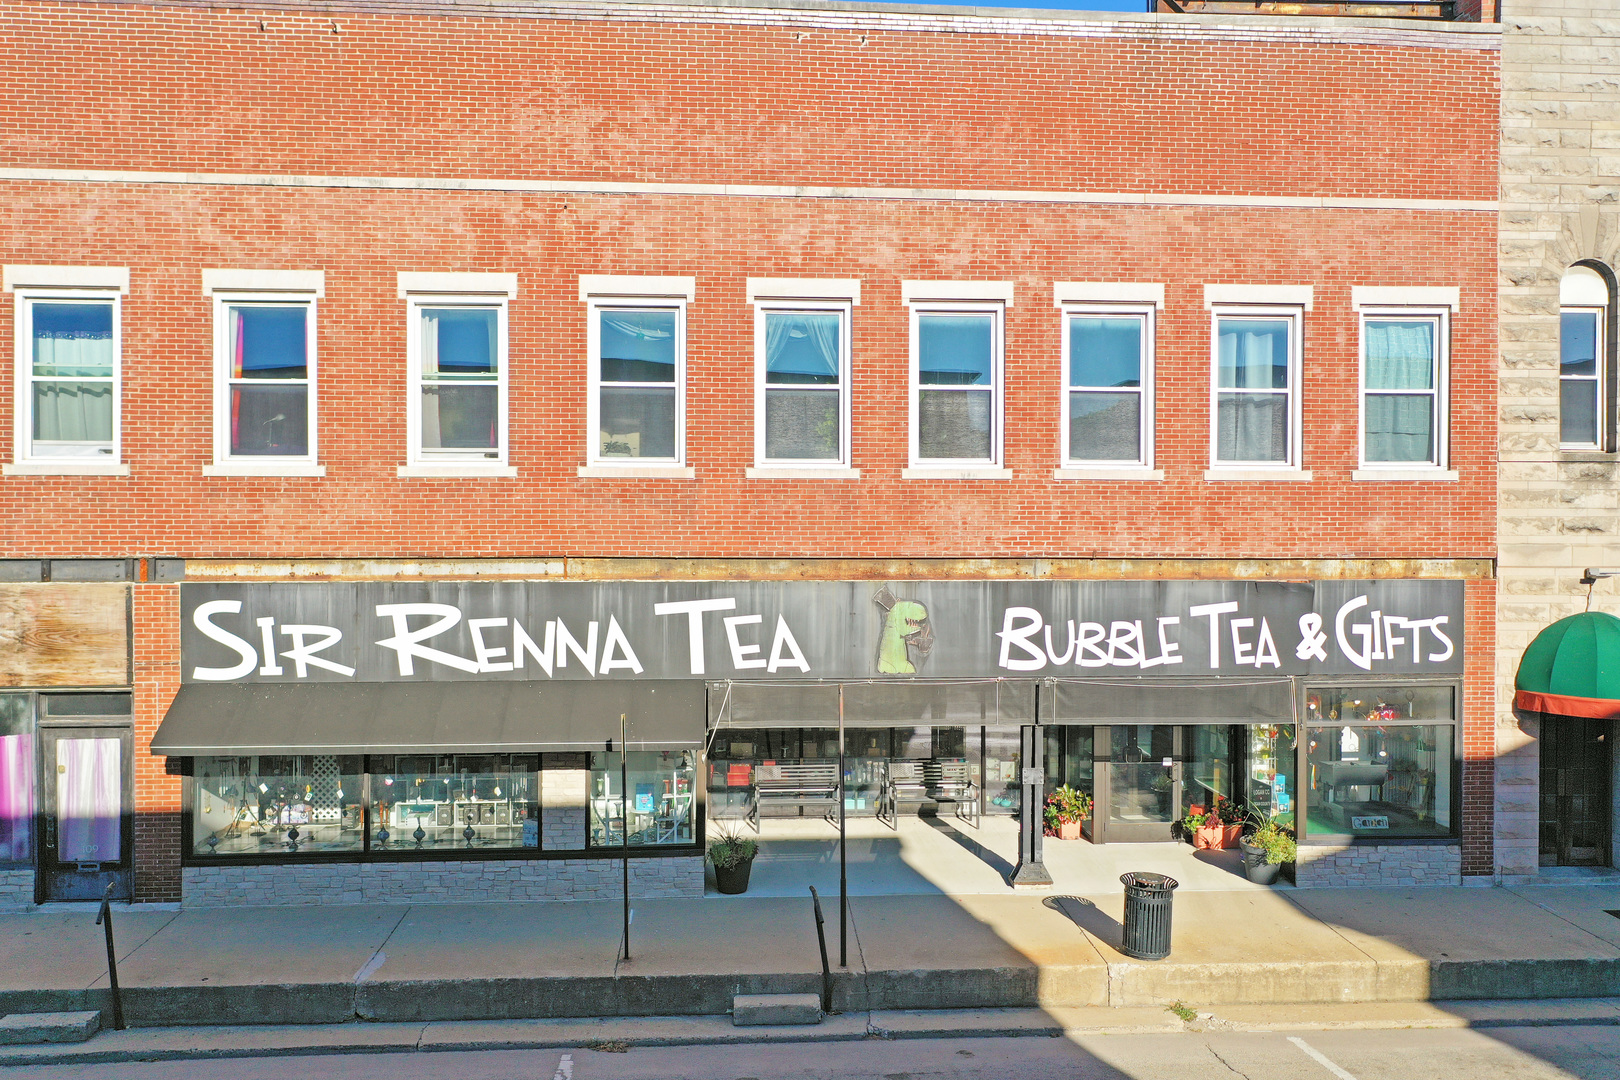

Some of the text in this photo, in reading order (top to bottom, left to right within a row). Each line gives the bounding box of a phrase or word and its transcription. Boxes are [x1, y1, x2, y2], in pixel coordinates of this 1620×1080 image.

[193, 597, 811, 681] SIR RENNA TEA
[995, 594, 1454, 671] BUBBLE TEA & GIFTS
